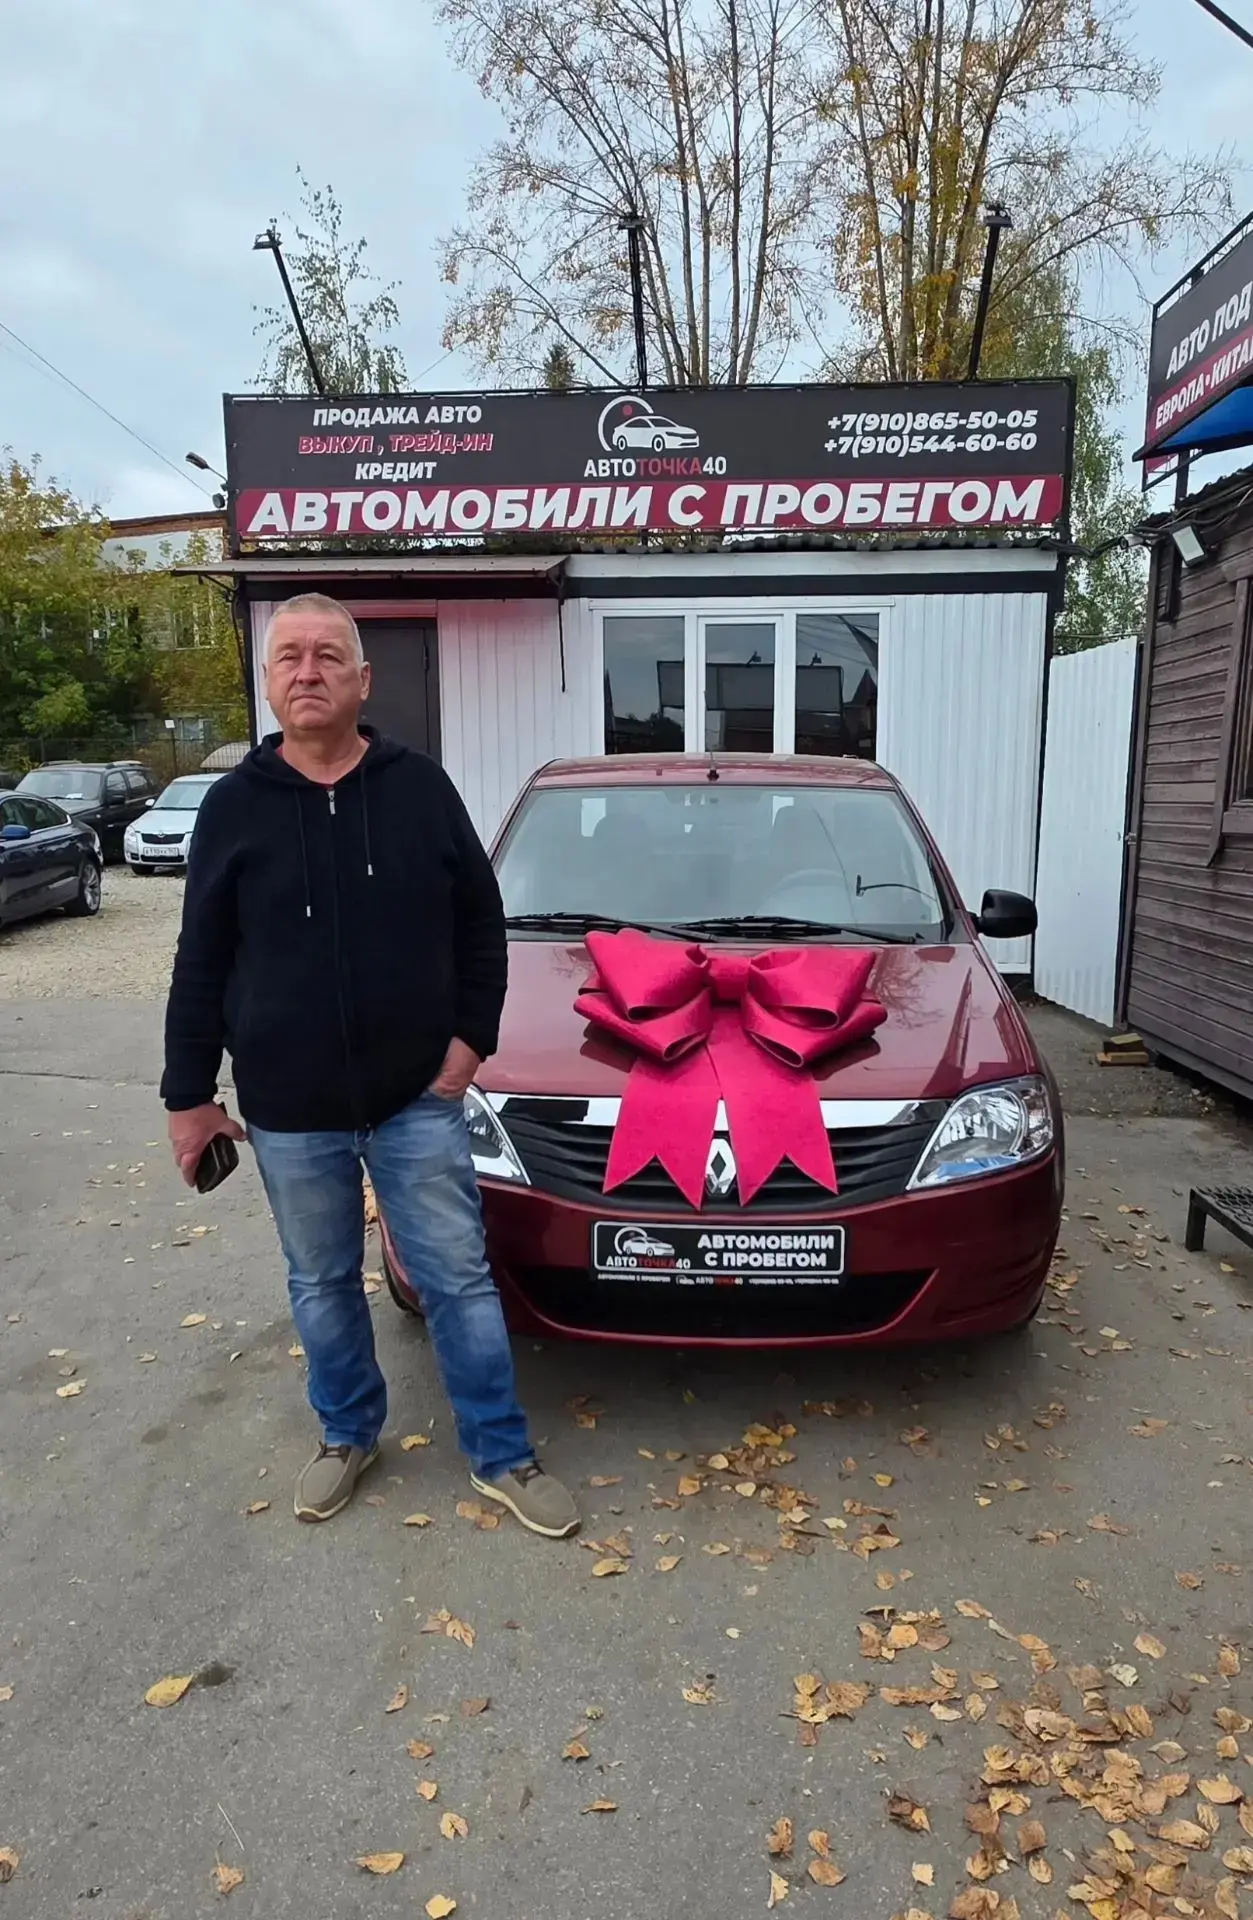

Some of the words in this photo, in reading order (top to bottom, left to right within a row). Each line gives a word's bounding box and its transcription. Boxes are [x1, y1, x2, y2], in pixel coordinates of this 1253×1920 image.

[1166, 318, 1210, 380] АВТО
[1211, 280, 1253, 342] ПОД
[1155, 373, 1204, 430] ЕВРОПА
[313, 407, 420, 428] ПРОДАЖА
[424, 405, 482, 424] АВТО
[828, 410, 1038, 434] +7(910)865-50-05
[388, 429, 494, 455] ТРЕЙД-ИН
[824, 433, 1037, 457] +7(910)544-60-60
[355, 461, 437, 482] КРЕДИТ
[583, 456, 727, 477] АВТОТОЧКА40
[247, 485, 654, 533] АВТОМОБИЛИ
[668, 484, 708, 526] С
[720, 479, 1046, 525] ПРОБЕГОМ
[697, 1234, 835, 1250] АВТОМОБИЛИ
[605, 1255, 692, 1270] АВТОТОЧКА40
[704, 1252, 718, 1267] С
[722, 1252, 827, 1268] ПРОБЕГОМ
